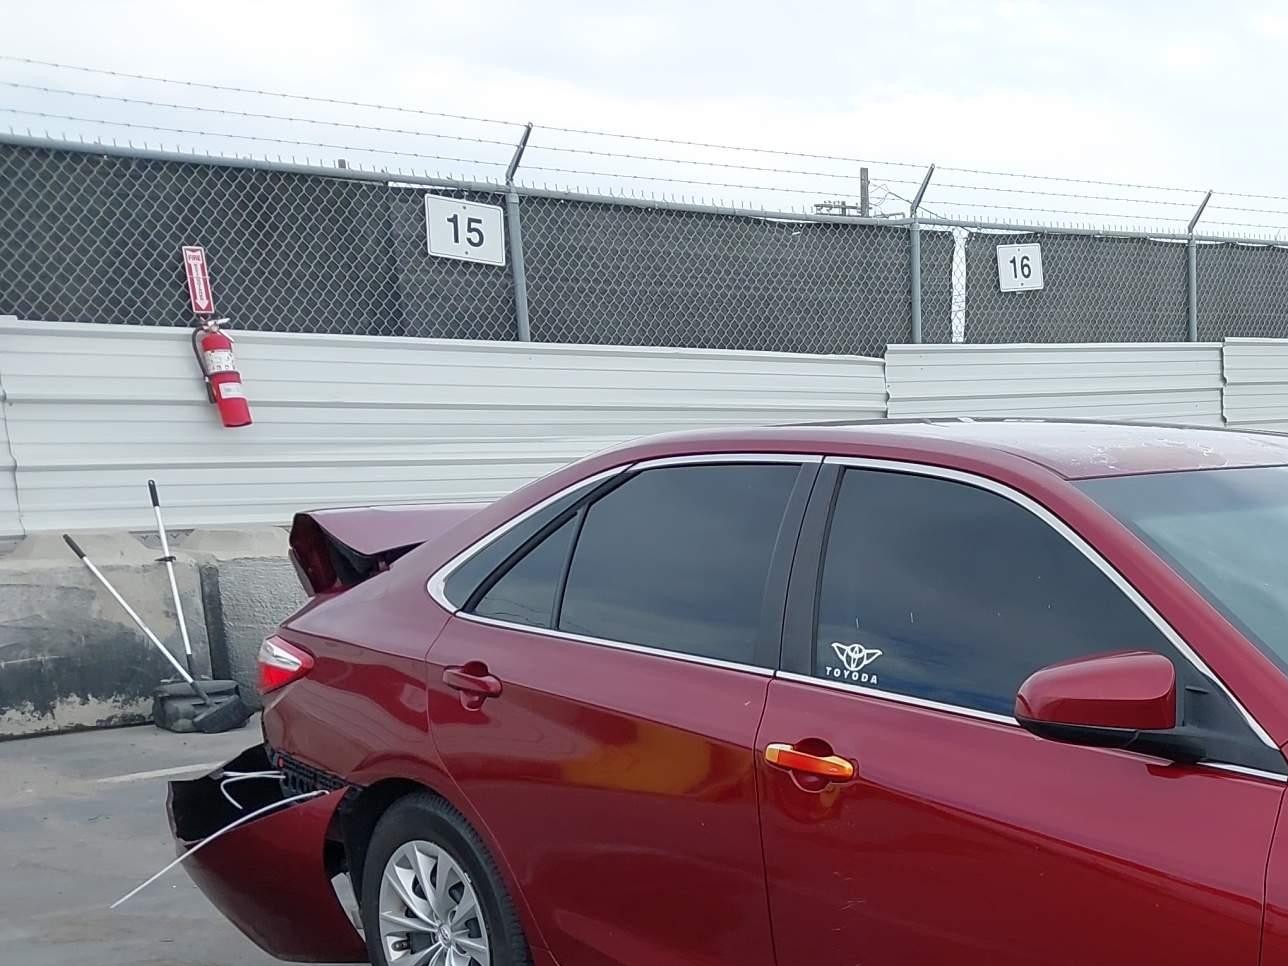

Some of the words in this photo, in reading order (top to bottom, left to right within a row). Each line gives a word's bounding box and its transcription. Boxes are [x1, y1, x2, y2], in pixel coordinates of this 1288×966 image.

[447, 213, 485, 248] 15
[1009, 255, 1032, 279] 16
[825, 666, 878, 684] TOYODA
